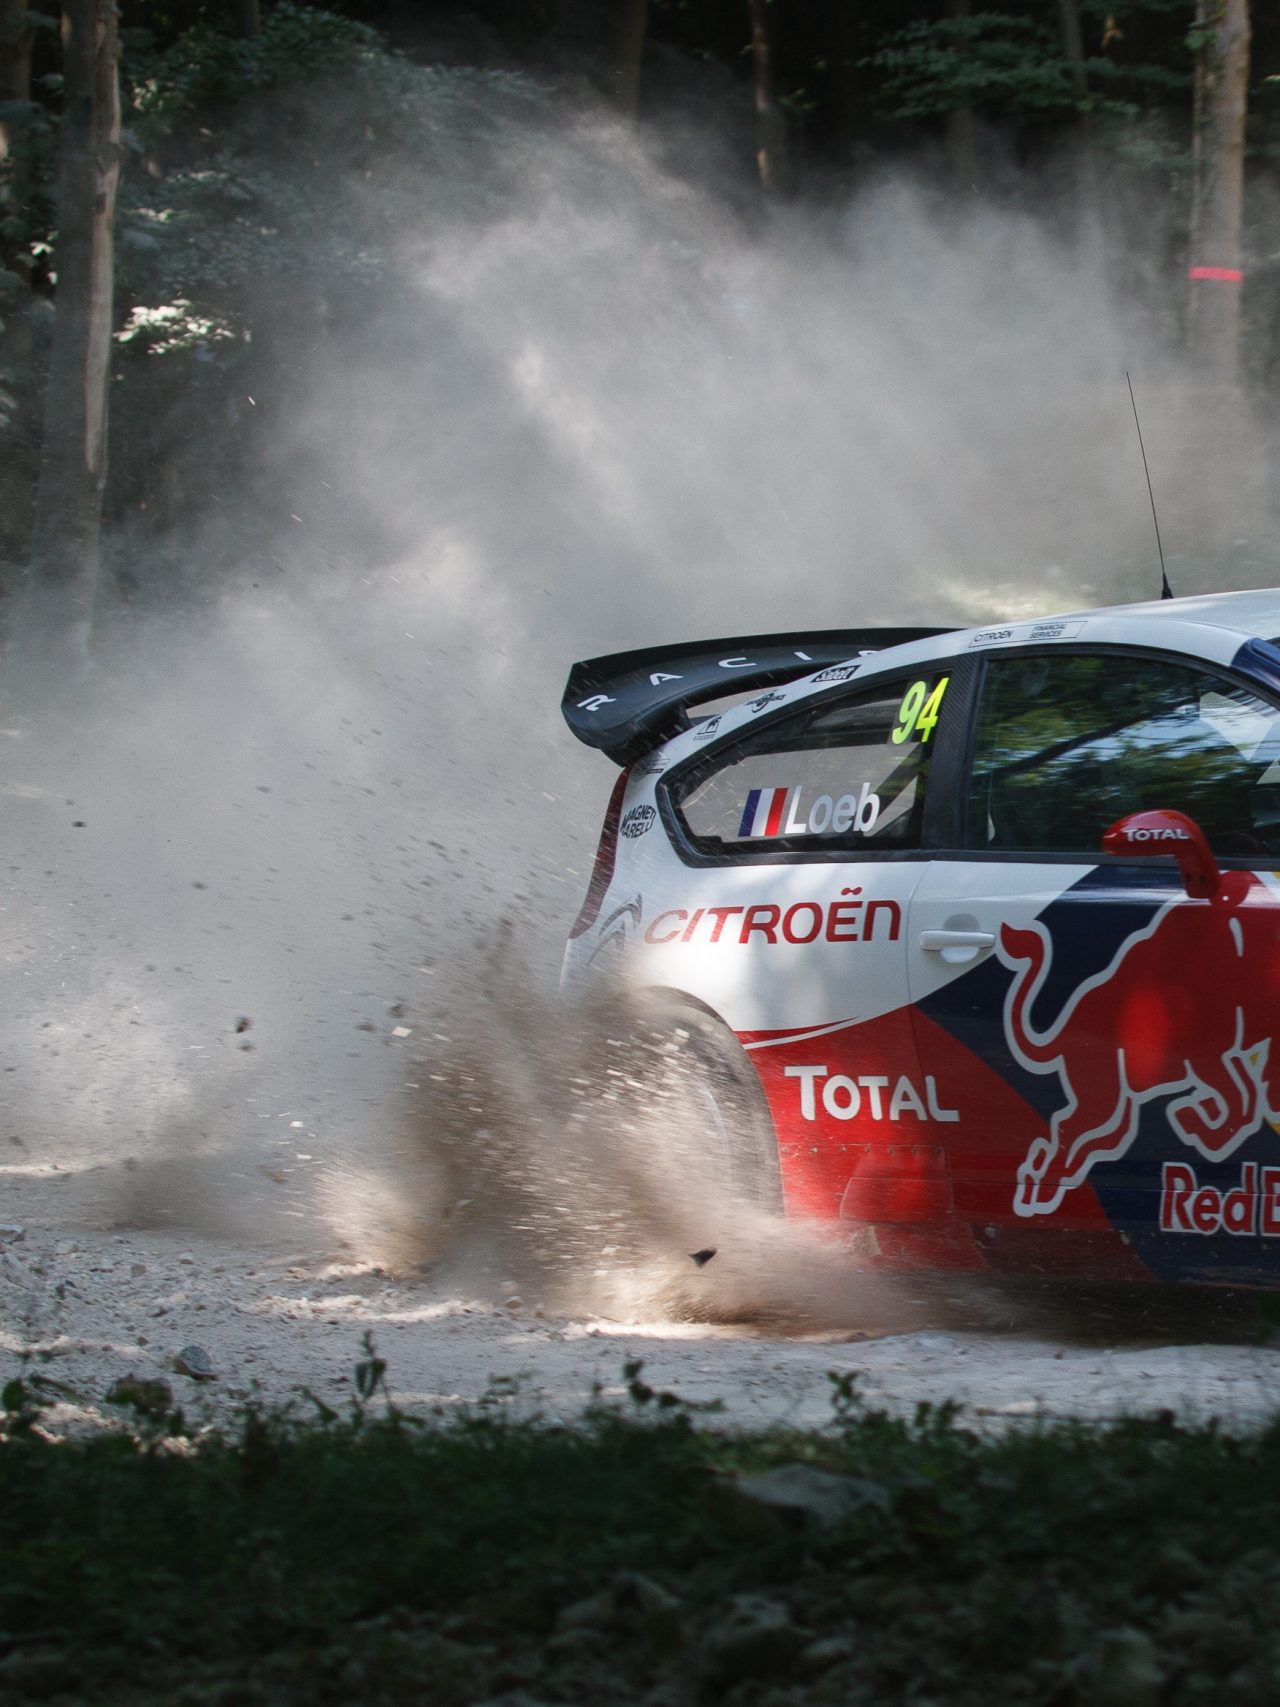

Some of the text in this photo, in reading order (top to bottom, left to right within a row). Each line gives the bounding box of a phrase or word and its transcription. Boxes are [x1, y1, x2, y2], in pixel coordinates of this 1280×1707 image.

[892, 677, 950, 744] 94
[784, 782, 880, 834] Loeb
[1126, 827, 1190, 843] TOTAL
[784, 1064, 960, 1122] TOTAL
[1160, 1161, 1258, 1236] Red
